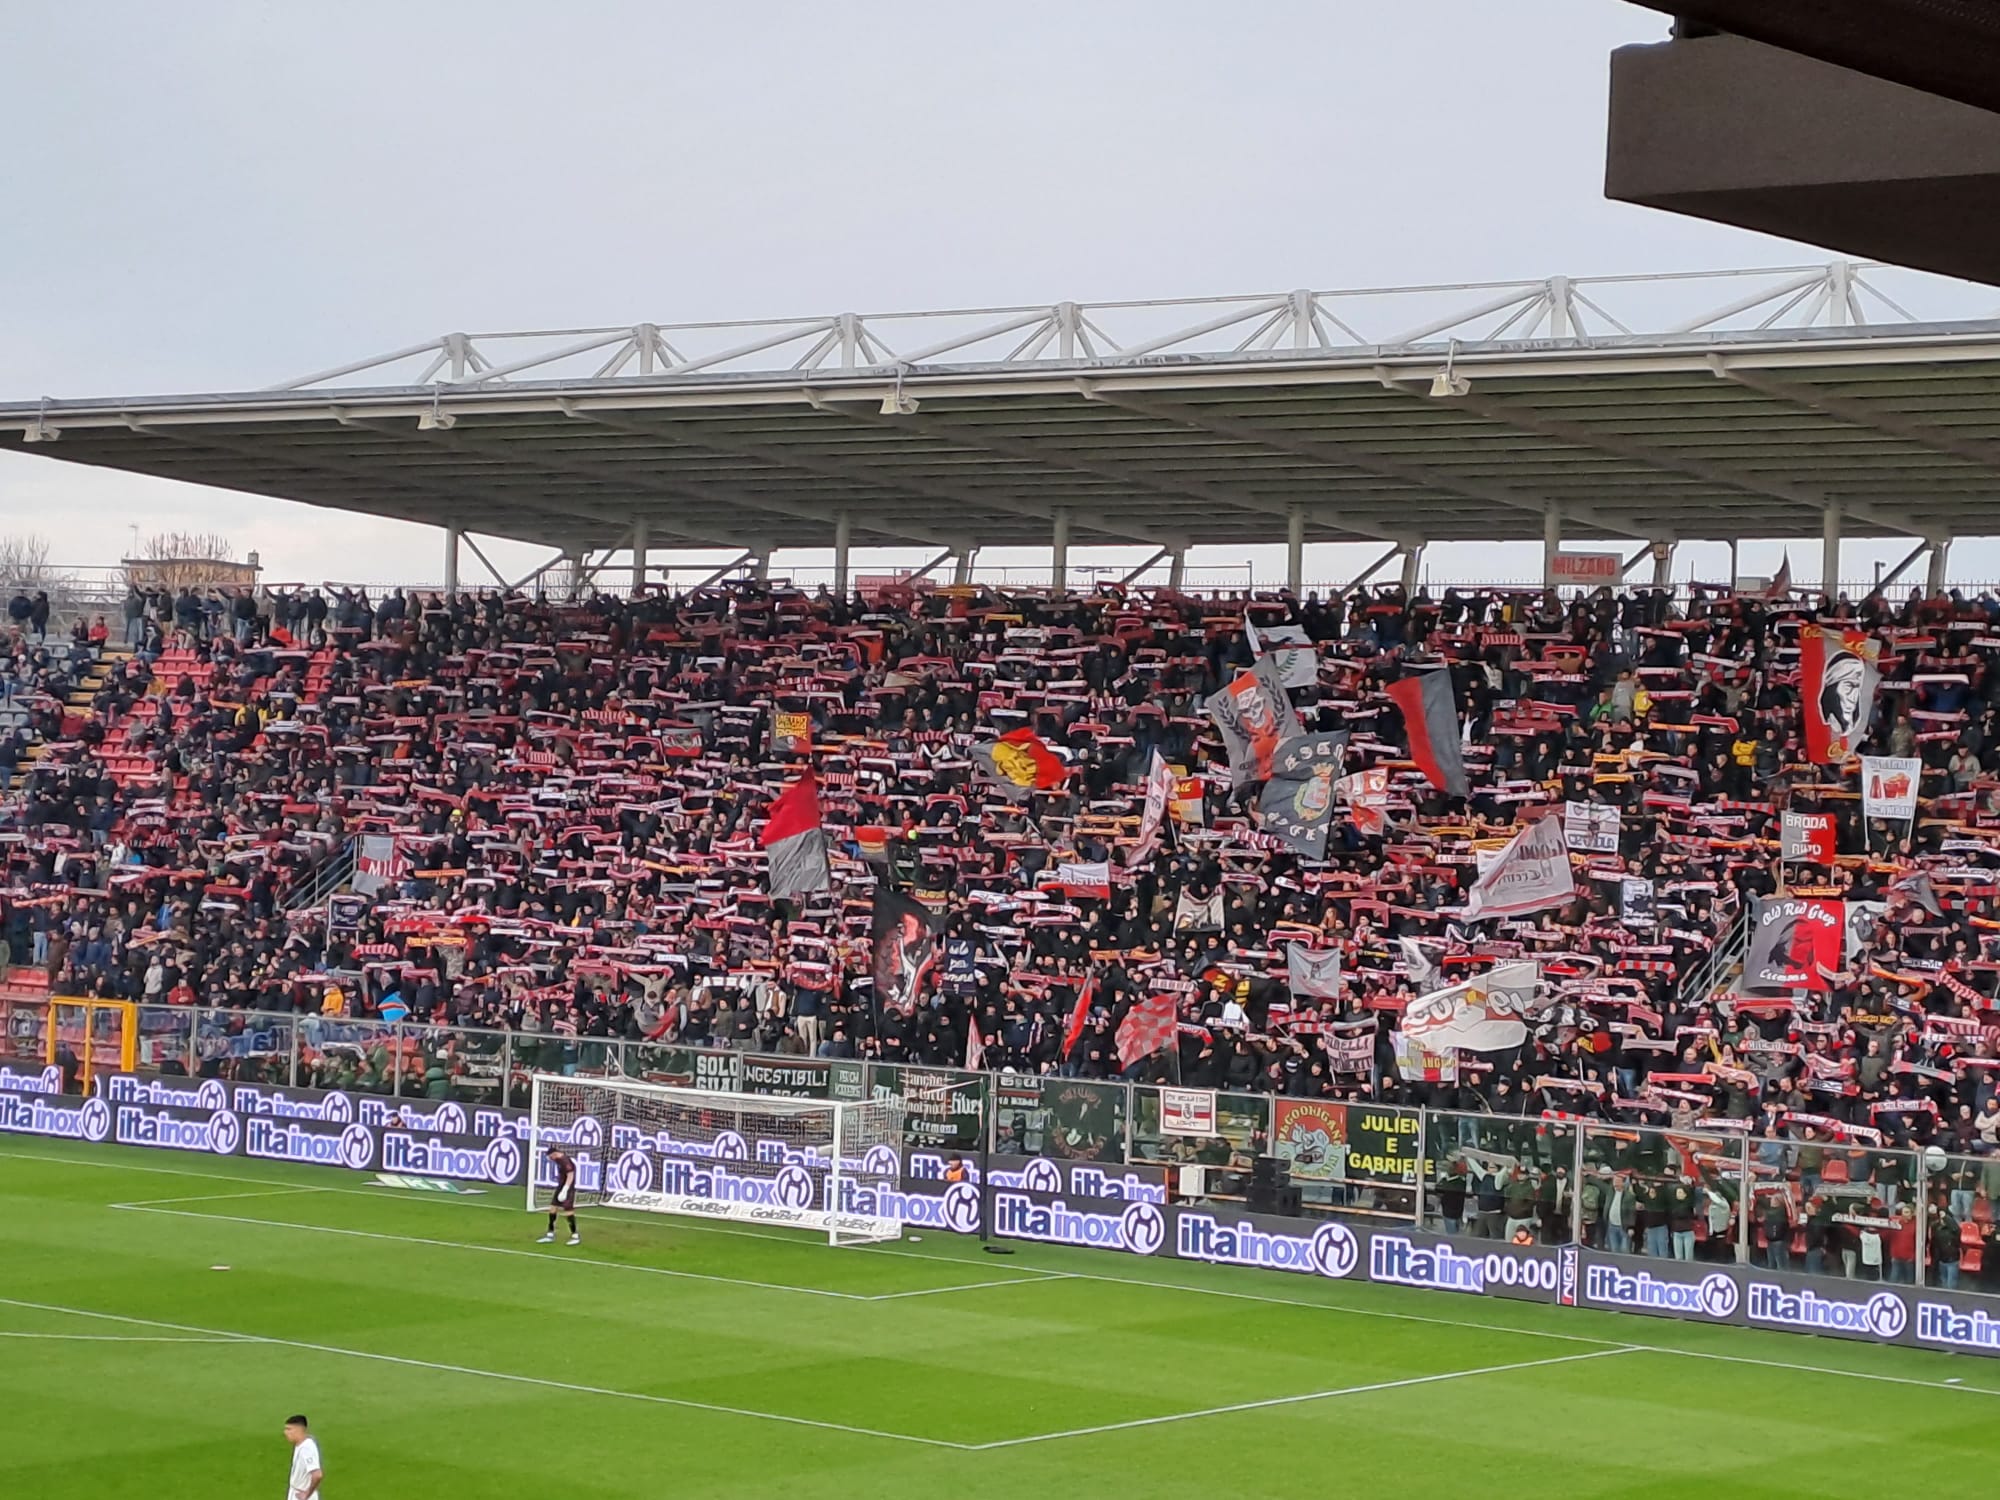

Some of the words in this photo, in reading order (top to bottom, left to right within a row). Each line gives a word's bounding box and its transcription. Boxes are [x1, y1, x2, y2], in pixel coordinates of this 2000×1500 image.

[1786, 815, 1828, 829] BRODA
[1802, 830, 1810, 842] E
[1763, 905, 1780, 926] Old
[1784, 902, 1807, 916] Red
[1807, 904, 1836, 927] Greg
[696, 1055, 738, 1077] SOLO
[118, 1107, 210, 1149] iltainox
[248, 1120, 342, 1164] iltainox
[1361, 1115, 1420, 1134] JULIEN
[384, 1134, 487, 1179] iltainox
[1386, 1138, 1398, 1153] E
[995, 1194, 1126, 1247] iltainox
[1178, 1214, 1316, 1271] iltainox
[1484, 1254, 1558, 1290] 00:00
[1587, 1266, 1700, 1311] iltainox
[1749, 1284, 1869, 1331] iltainox
